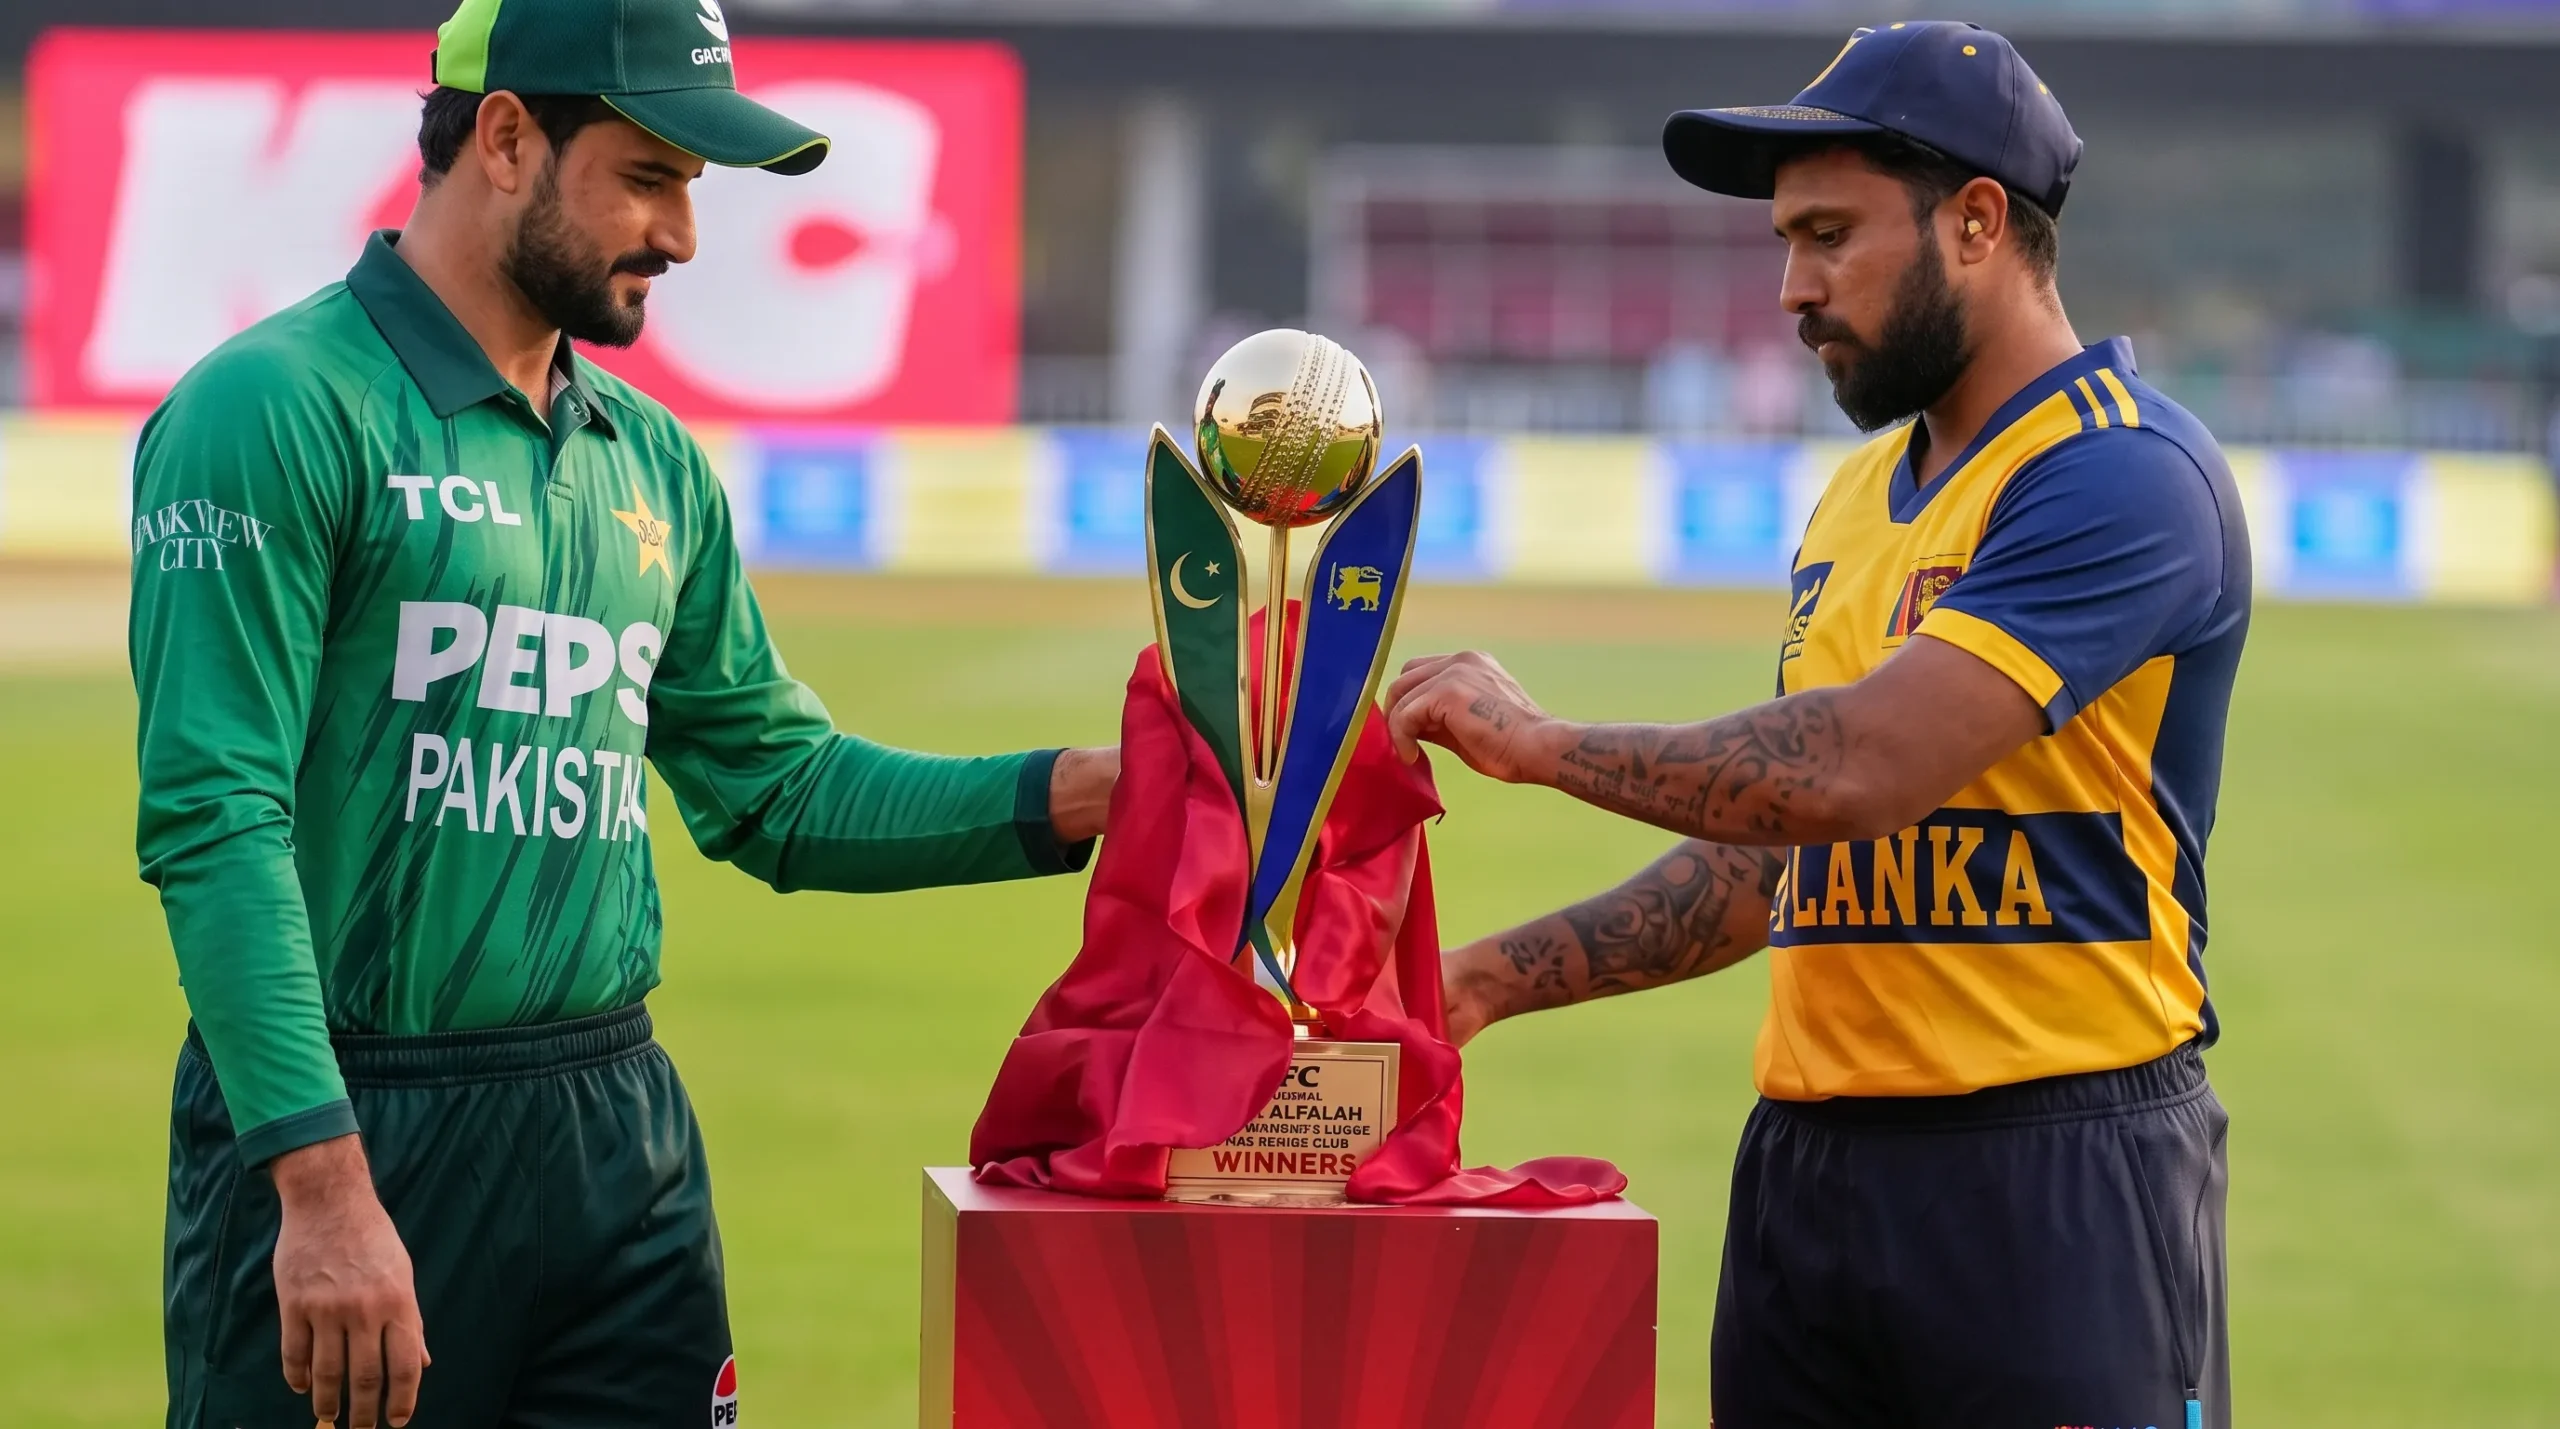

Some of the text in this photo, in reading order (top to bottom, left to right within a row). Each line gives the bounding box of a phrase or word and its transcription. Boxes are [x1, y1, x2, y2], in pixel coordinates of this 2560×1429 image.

[81, 75, 954, 409] KC
[387, 475, 521, 525] TCL
[160, 538, 227, 572] CITY
[1791, 826, 2052, 928] LANKA
[1269, 1104, 1362, 1121] ALFALAH
[1313, 1137, 1349, 1149] CLUB
[1324, 1124, 1371, 1136] LUGGE
[1213, 1150, 1357, 1176] WINNERS
